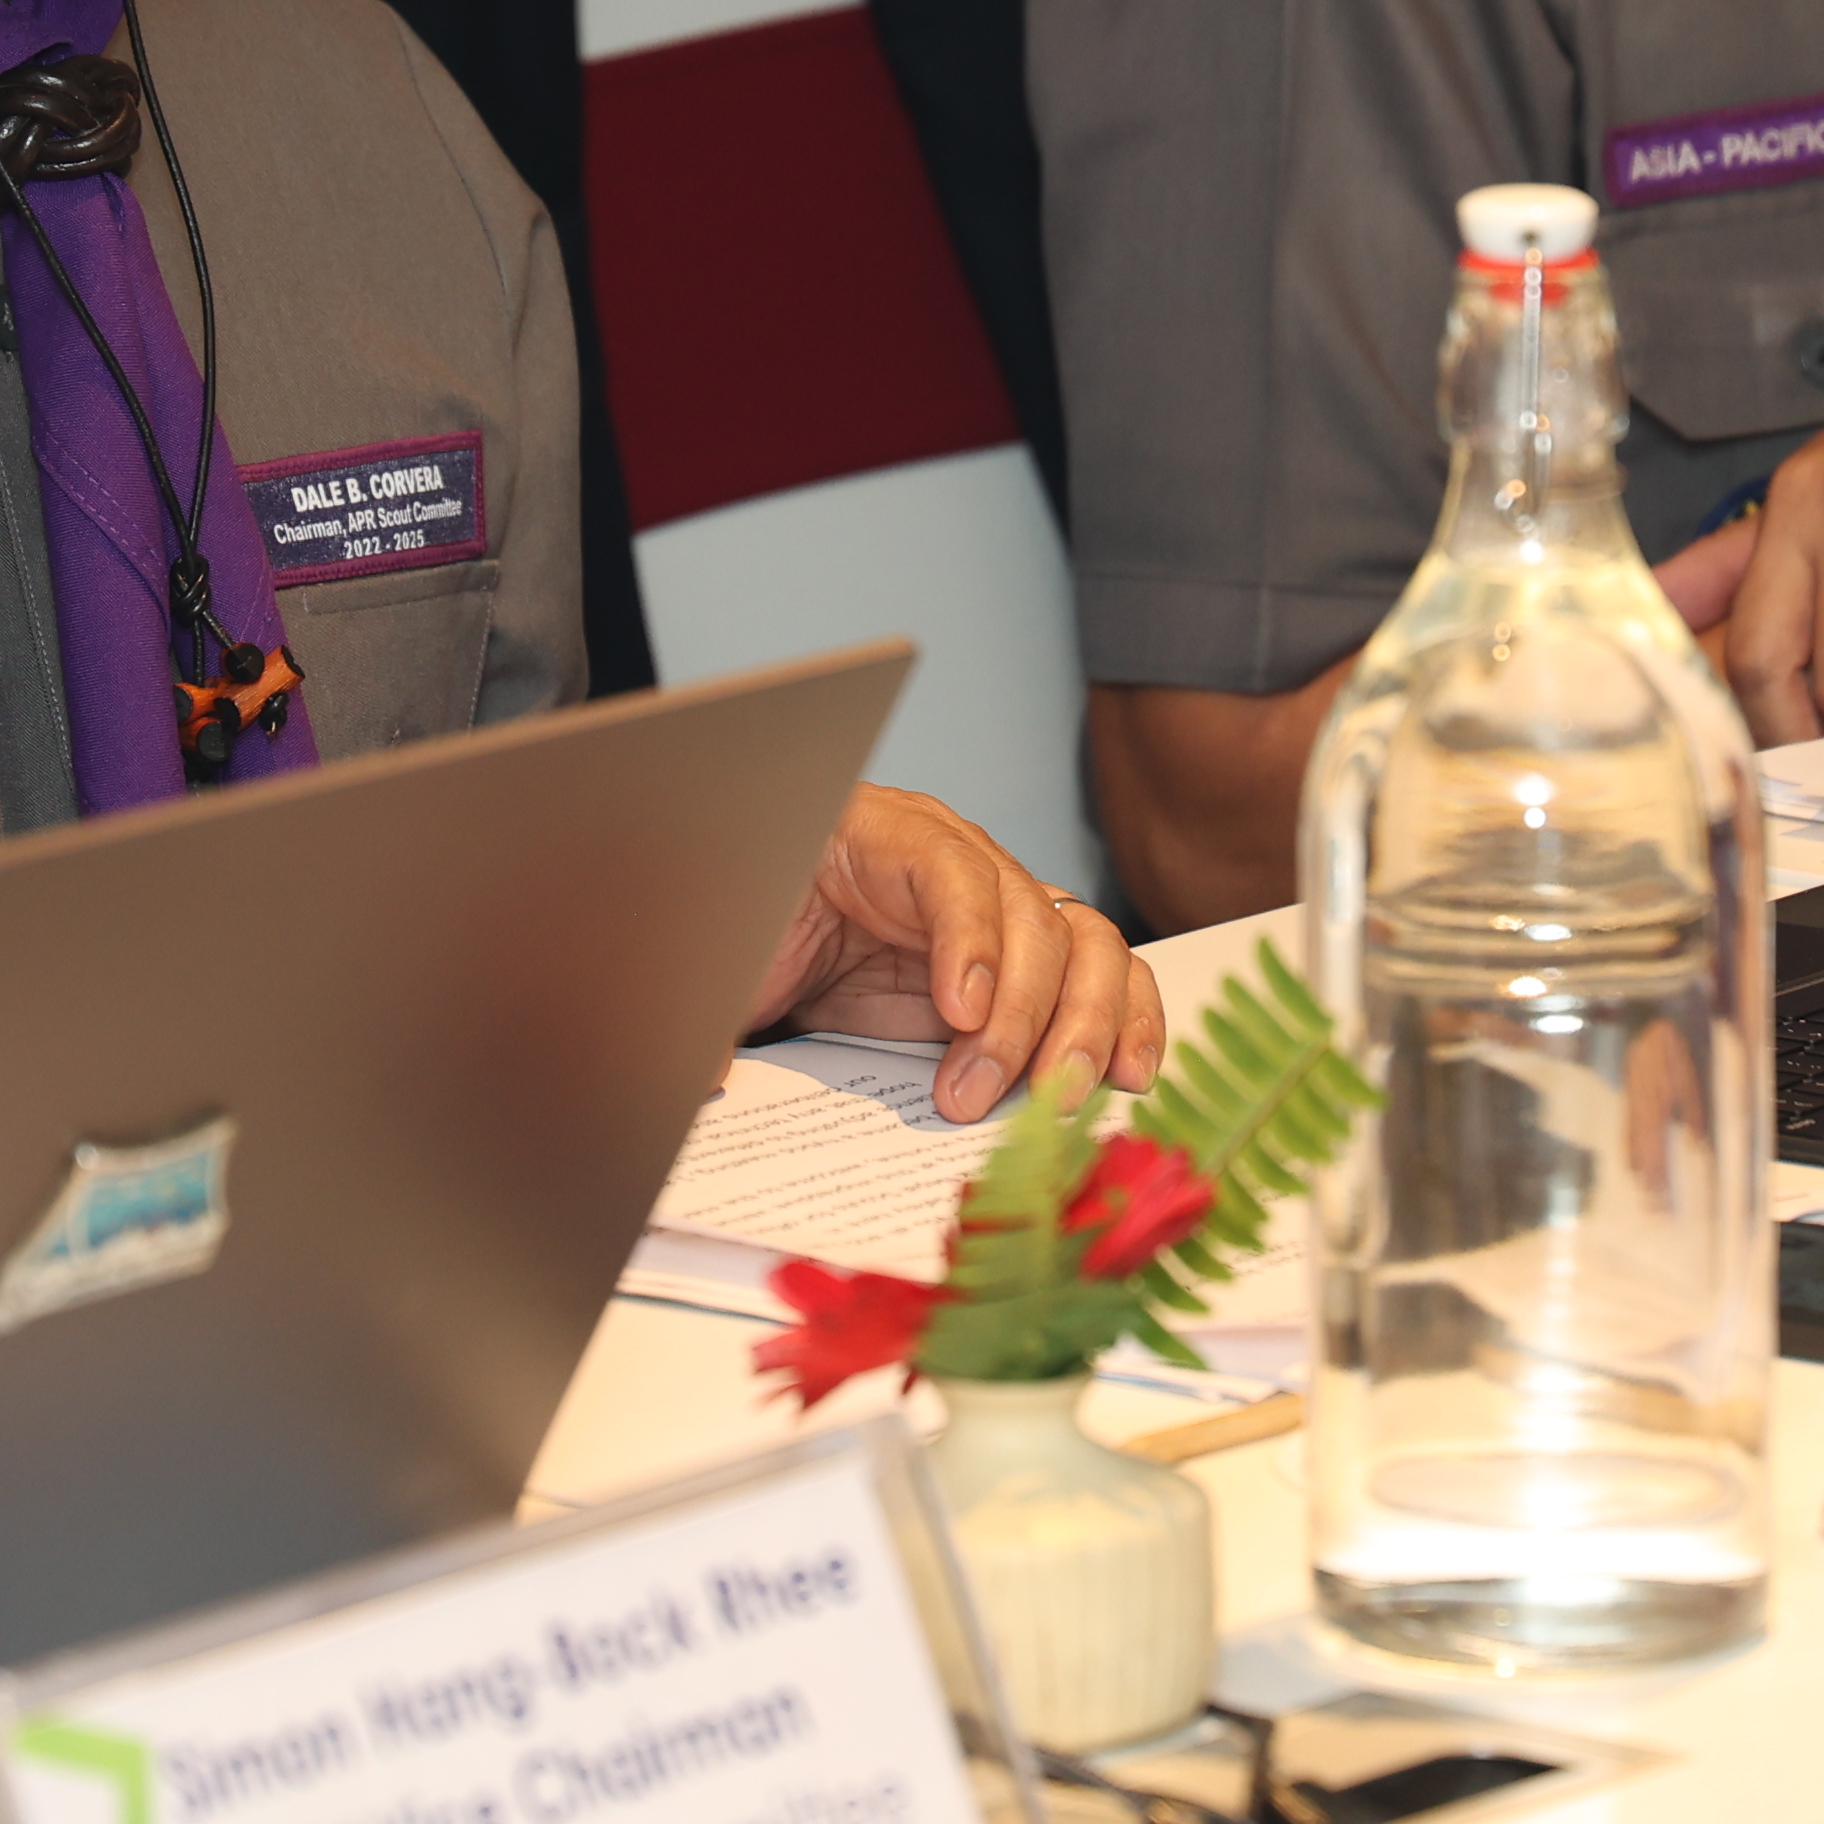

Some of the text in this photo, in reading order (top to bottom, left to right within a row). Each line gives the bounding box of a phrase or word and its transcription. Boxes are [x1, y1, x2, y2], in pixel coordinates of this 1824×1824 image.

[1629, 138, 1703, 185] ASIA
[291, 465, 444, 513] DALE B. CORVERA
[273, 496, 463, 545] Chairman, APR Scout Committee
[343, 536, 382, 560] 2022
[394, 529, 426, 551] 2025
[704, 1546, 864, 1640] Rhee
[516, 1682, 814, 1821] Chairman
